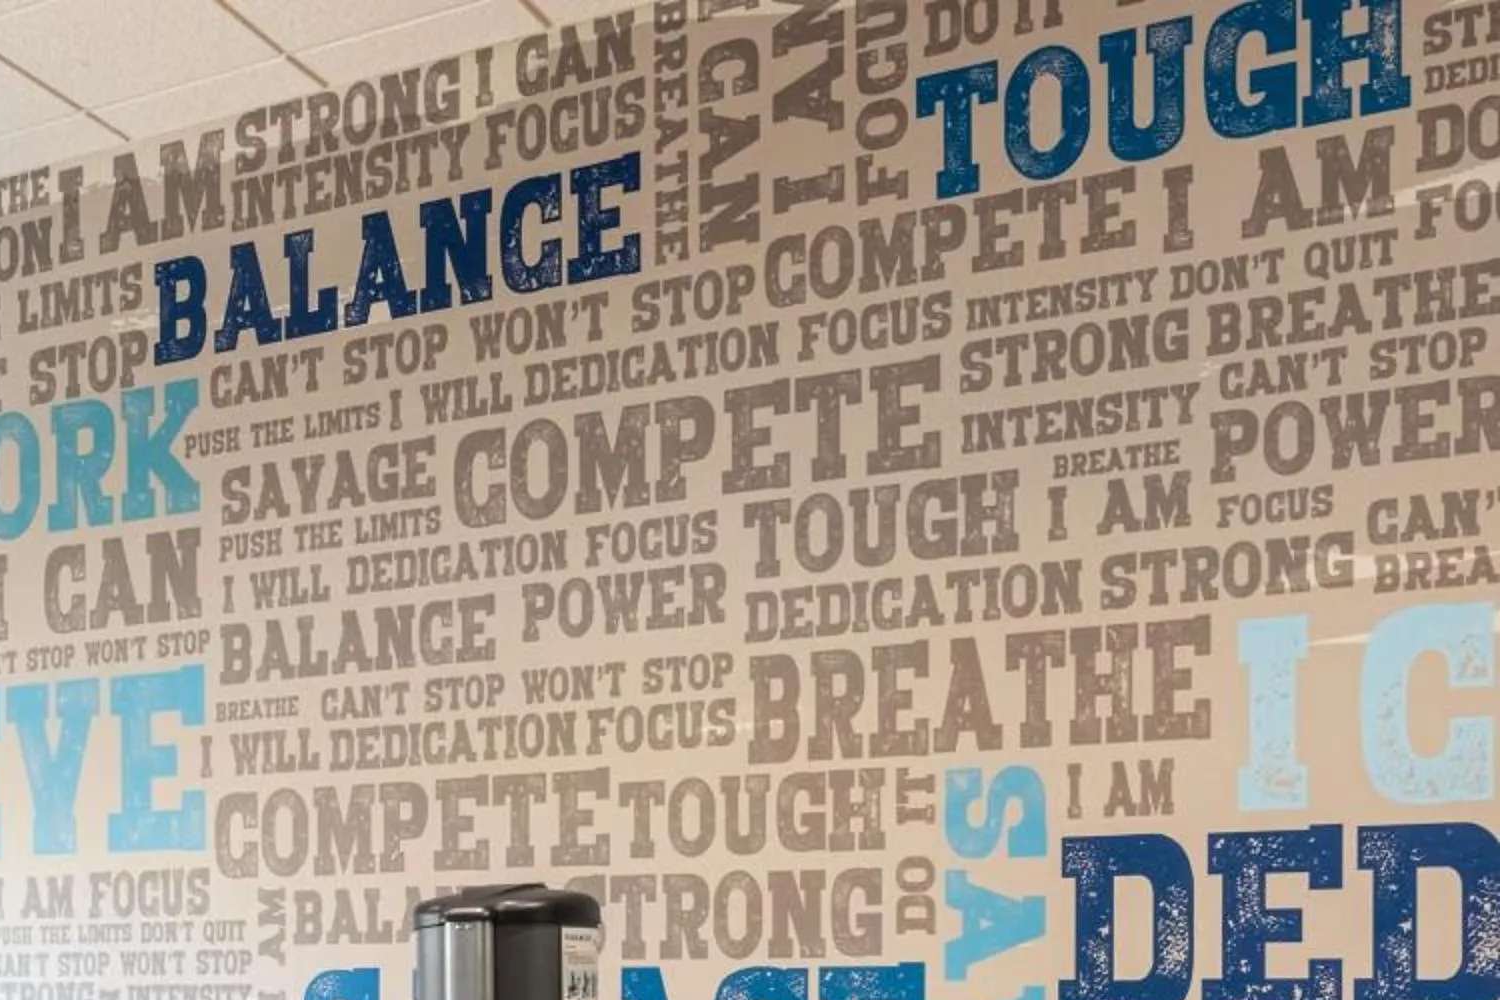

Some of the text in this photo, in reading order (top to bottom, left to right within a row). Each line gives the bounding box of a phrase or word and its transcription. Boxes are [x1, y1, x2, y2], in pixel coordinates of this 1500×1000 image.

[924, 0, 998, 57] DO
[235, 58, 461, 174] STRONG
[516, 11, 635, 97] CAN
[697, 37, 761, 253] CAN
[916, 0, 1411, 199] TOUGH
[58, 129, 225, 264] I AM
[231, 77, 646, 232] INTENSITY FOCUS
[154, 152, 641, 366] BALANCE
[764, 126, 1395, 308] COMPETE I AM
[17, 262, 142, 334] LIMITS
[960, 258, 1500, 393] STRONG BREATHE
[966, 228, 1398, 331] INTENSITY DON'T QUIT
[29, 330, 148, 406] STOP
[184, 426, 240, 459] PUSH
[251, 416, 294, 449] THE
[305, 401, 380, 438] LIMITS
[420, 372, 512, 425] WILL
[525, 321, 780, 406] DEDICATION
[798, 290, 952, 361] FOCUS
[211, 264, 755, 408] CAN'T STOP WON'T STOP
[1219, 327, 1488, 400] CAN'T STOP
[221, 353, 941, 529] SAVAGE COMPETE
[961, 382, 1200, 454] INTENSITY
[1053, 439, 1181, 479] BREATHE
[1210, 374, 1500, 484] POWER
[220, 506, 441, 562] PUSH THE LIMITS
[250, 469, 1019, 609] WILL DEDICATION FOCUS TOUGH
[1048, 470, 1192, 542] I AM
[1217, 483, 1334, 528] FOCUS
[45, 527, 201, 634] CAN
[220, 562, 727, 685] BALANCE POWER
[744, 530, 1354, 643] DEDICATION STRONG
[26, 645, 74, 672] STOP
[157, 629, 210, 659] STOP
[216, 652, 733, 722] BREATHE CAN'T STOP WON'T STOP
[230, 614, 1211, 776] WILL DEDICATION FOCUS BREATHE
[1237, 613, 1310, 811] I
[215, 766, 885, 879] COMPETE TOUGH
[1103, 758, 1174, 817] AM
[21, 867, 210, 919] AM FOCUS
[895, 767, 936, 935] DO IT
[57, 952, 110, 977] STOP
[196, 950, 253, 976] STOP
[203, 920, 246, 943] QUIT
[258, 886, 286, 967] AM
